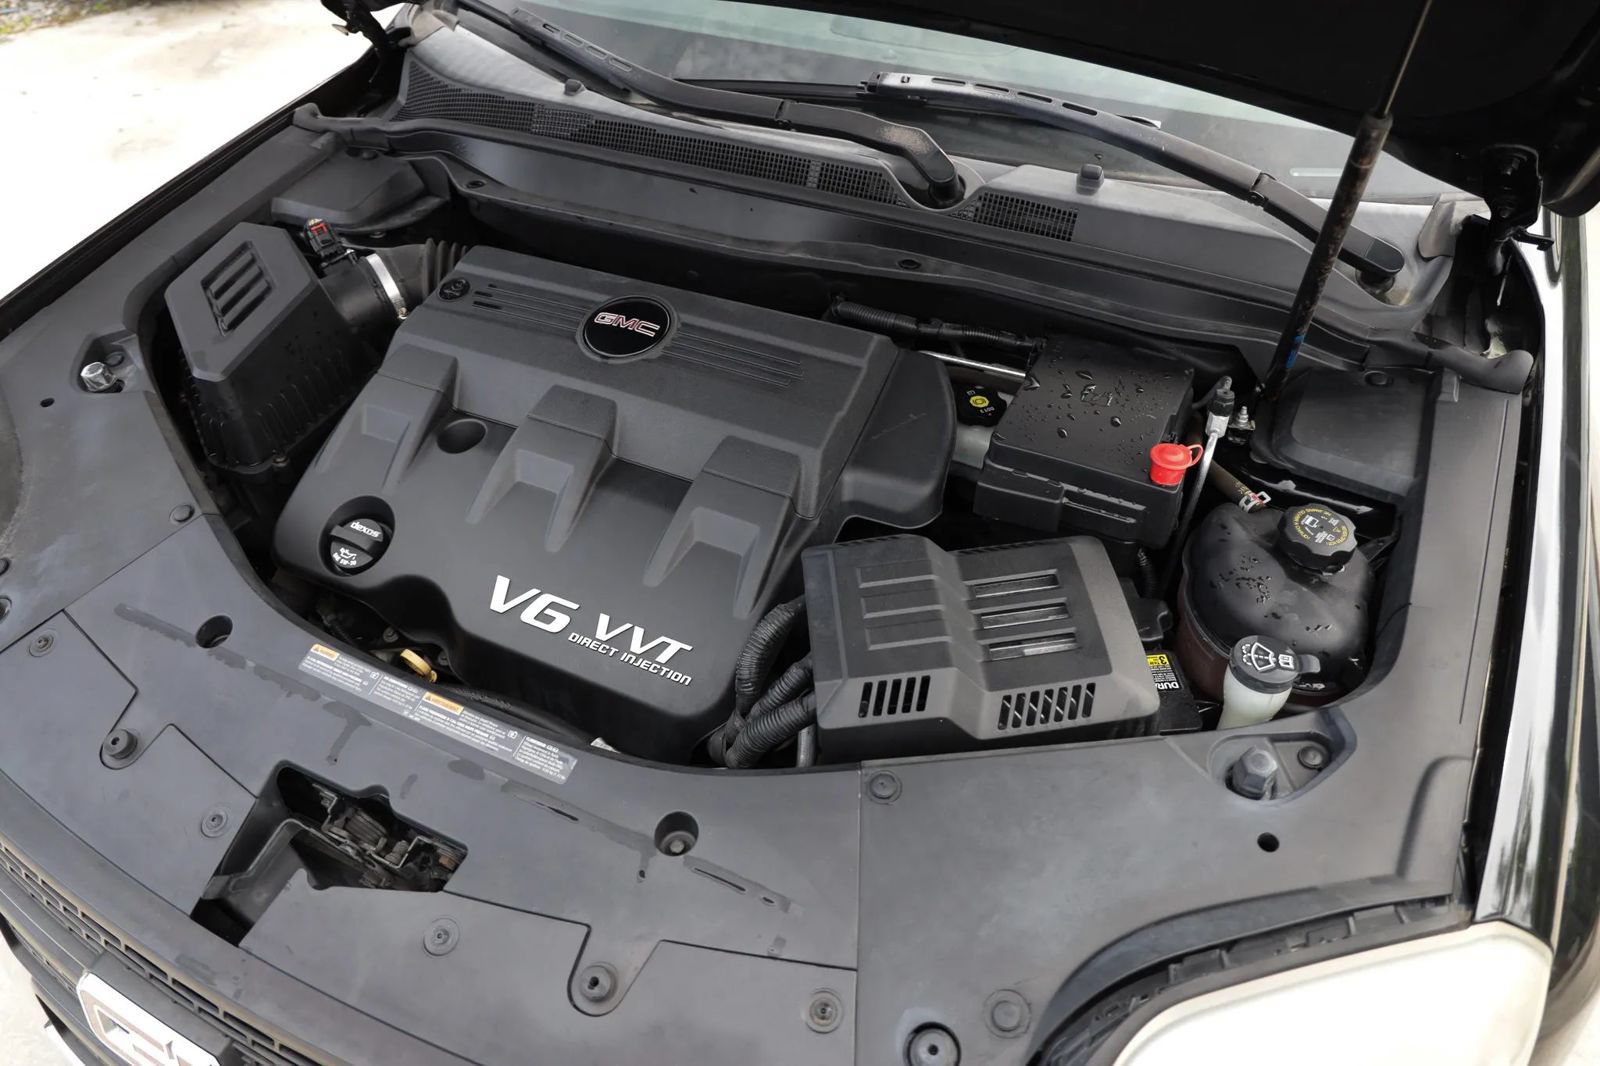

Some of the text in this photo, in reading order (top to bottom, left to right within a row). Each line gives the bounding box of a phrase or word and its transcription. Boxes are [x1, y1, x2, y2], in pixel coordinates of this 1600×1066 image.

[594, 311, 661, 338] GMC
[350, 521, 382, 538] dexos
[489, 574, 693, 664] V6 VVT
[567, 632, 692, 686] DIRECT INJECTION
